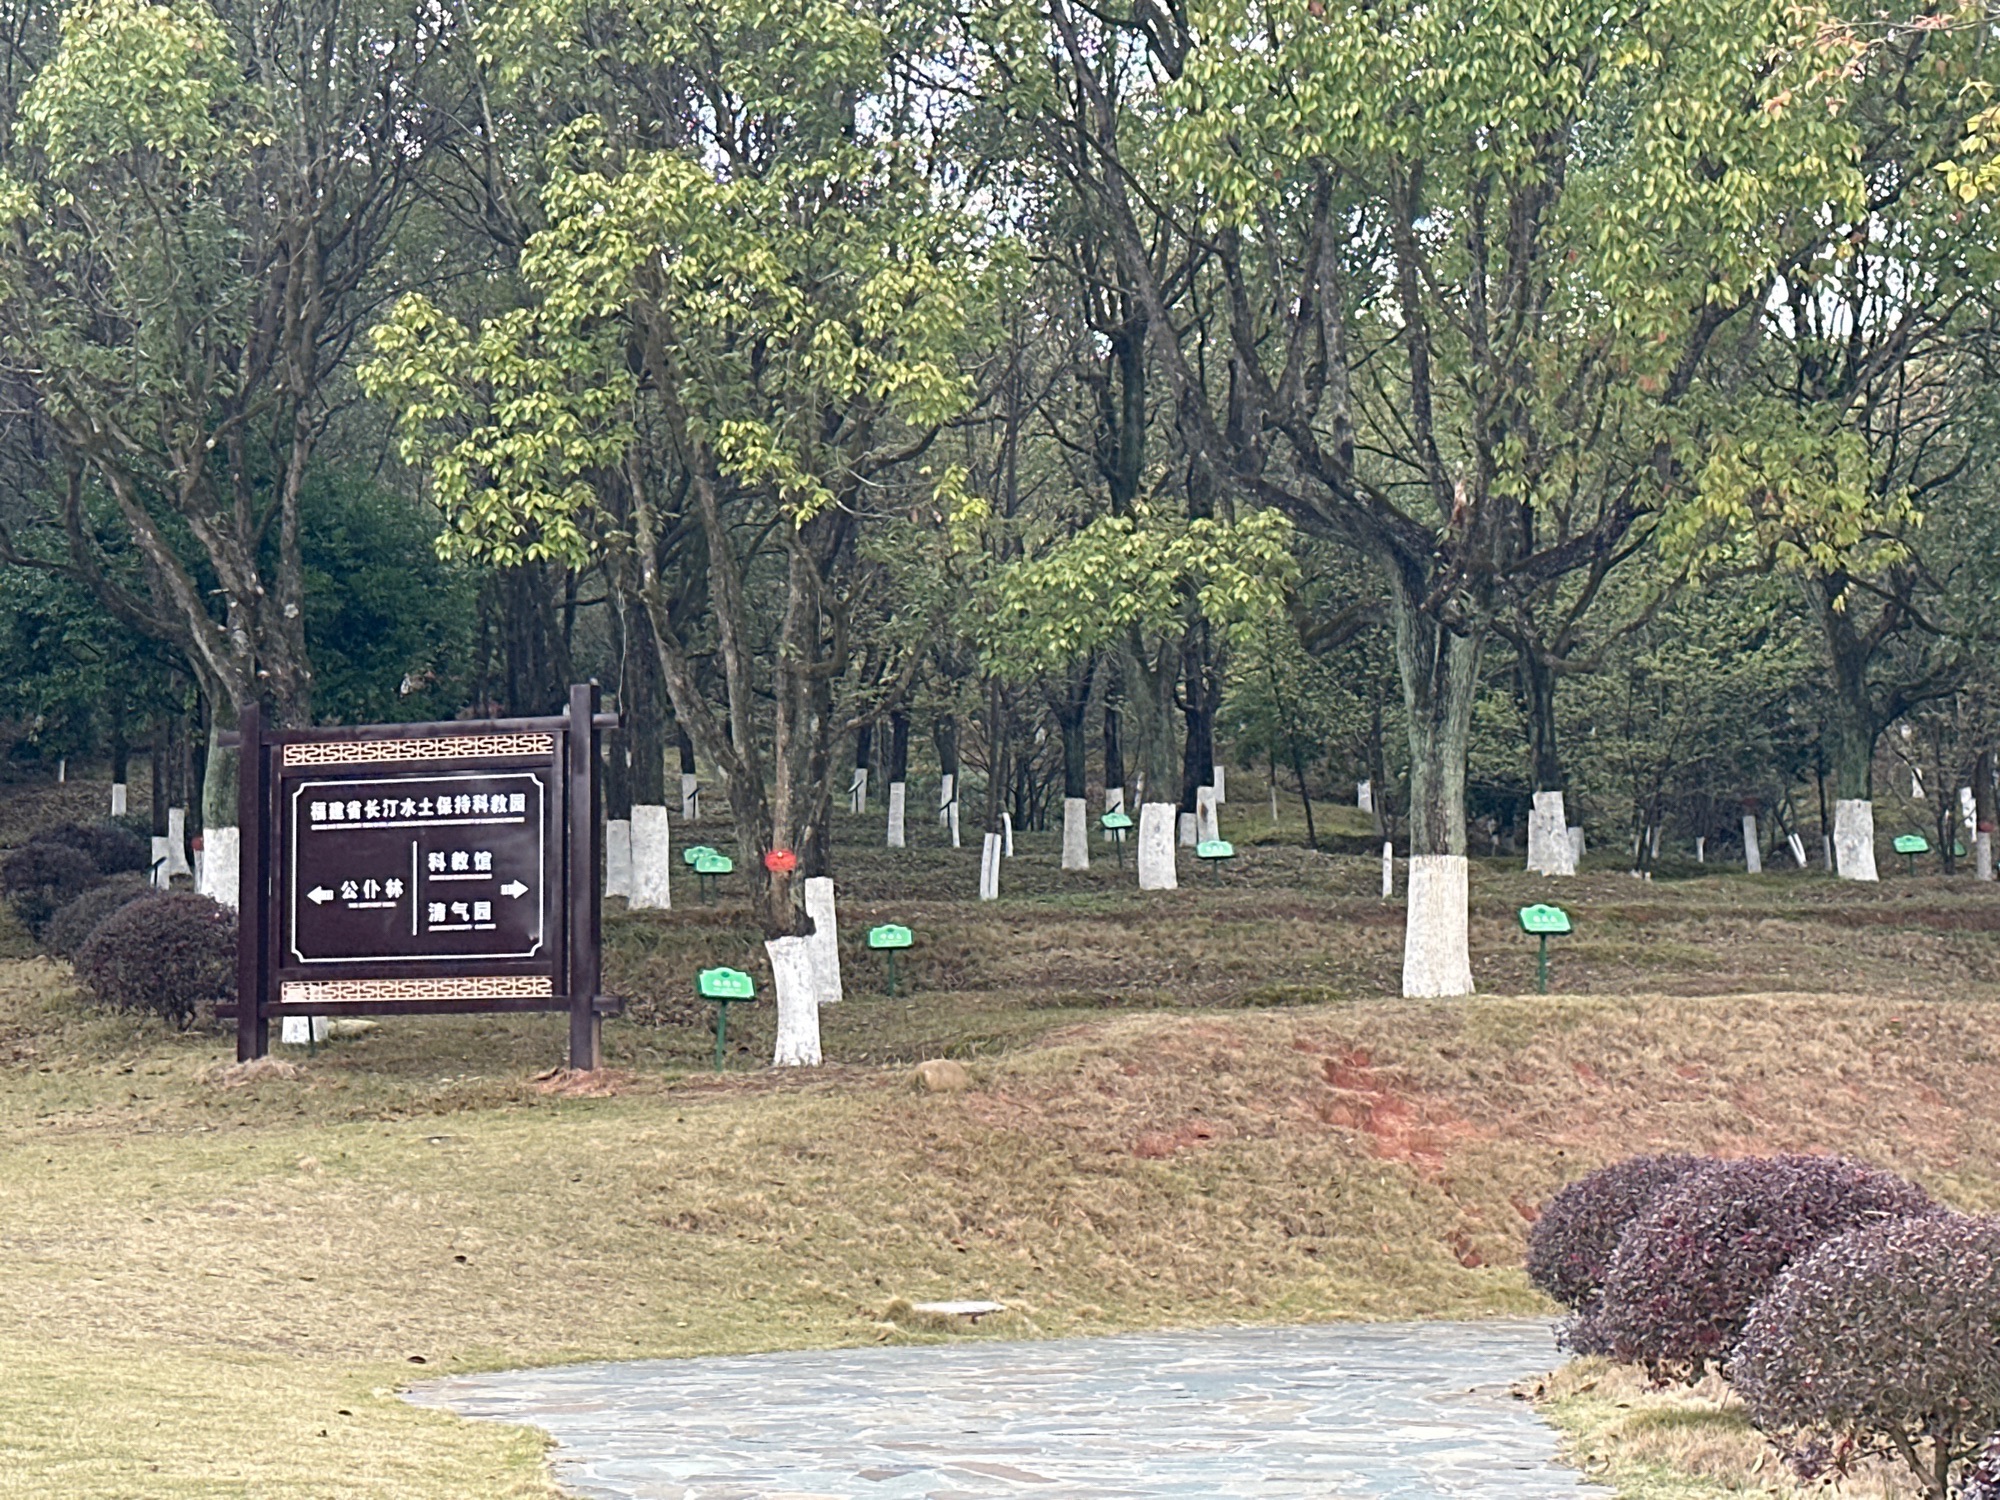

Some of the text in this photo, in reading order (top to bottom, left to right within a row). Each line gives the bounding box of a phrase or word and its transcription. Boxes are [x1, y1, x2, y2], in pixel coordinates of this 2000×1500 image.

[310, 793, 526, 821] 福建省长汀水土保持科教园
[428, 851, 492, 871] 科教馆
[340, 878, 404, 899] 公仆林
